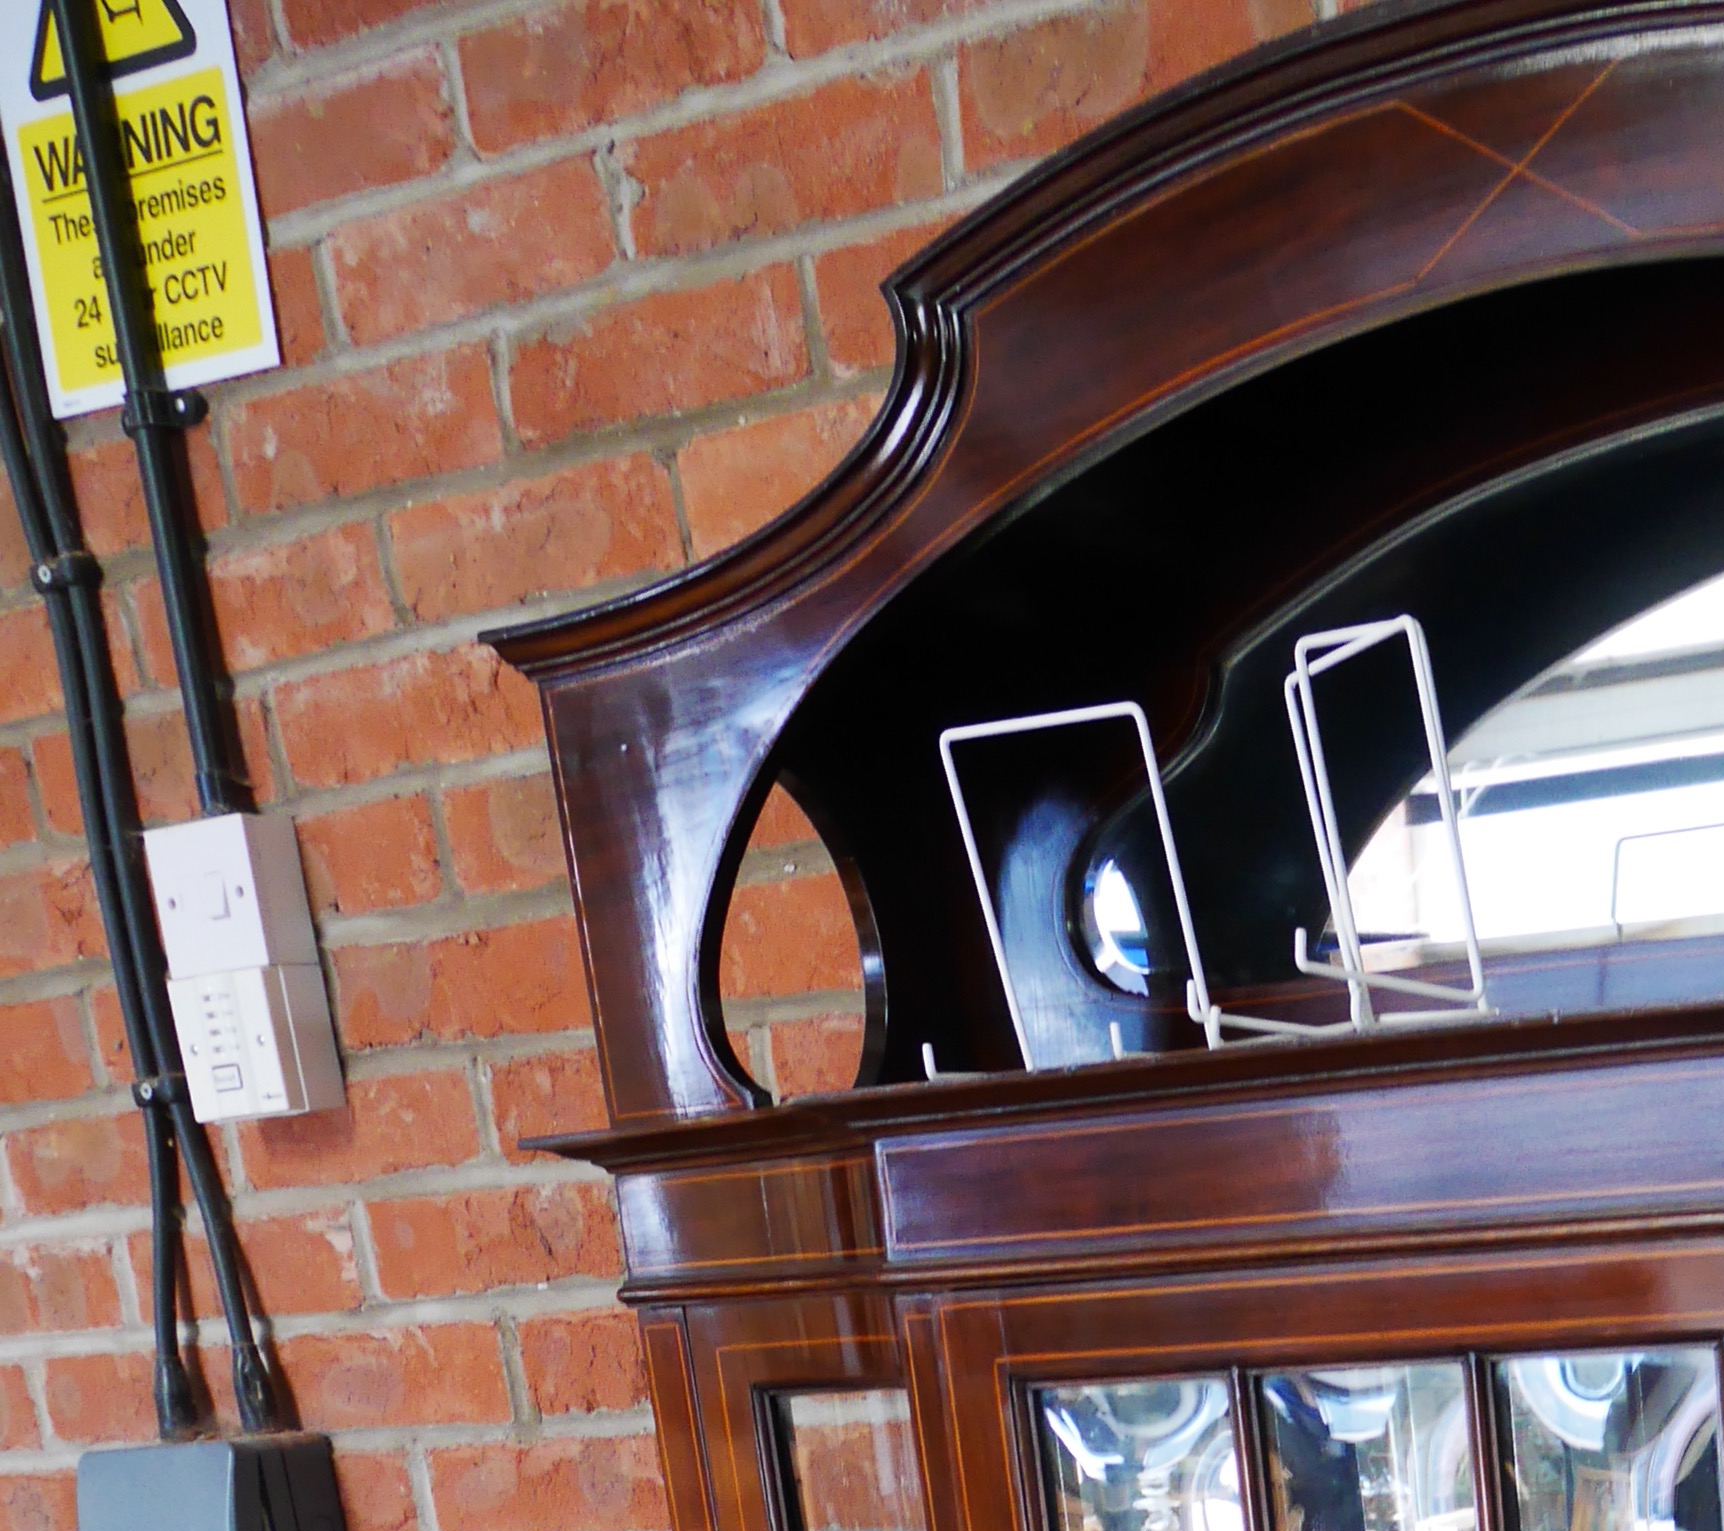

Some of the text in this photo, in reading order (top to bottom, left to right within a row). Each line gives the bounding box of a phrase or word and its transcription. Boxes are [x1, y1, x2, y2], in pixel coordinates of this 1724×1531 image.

[33, 95, 222, 192] WANING
[48, 212, 97, 245] The
[144, 230, 196, 266] nder
[74, 295, 102, 329] 24
[164, 260, 228, 304] CCTV
[95, 315, 224, 368] sullance
